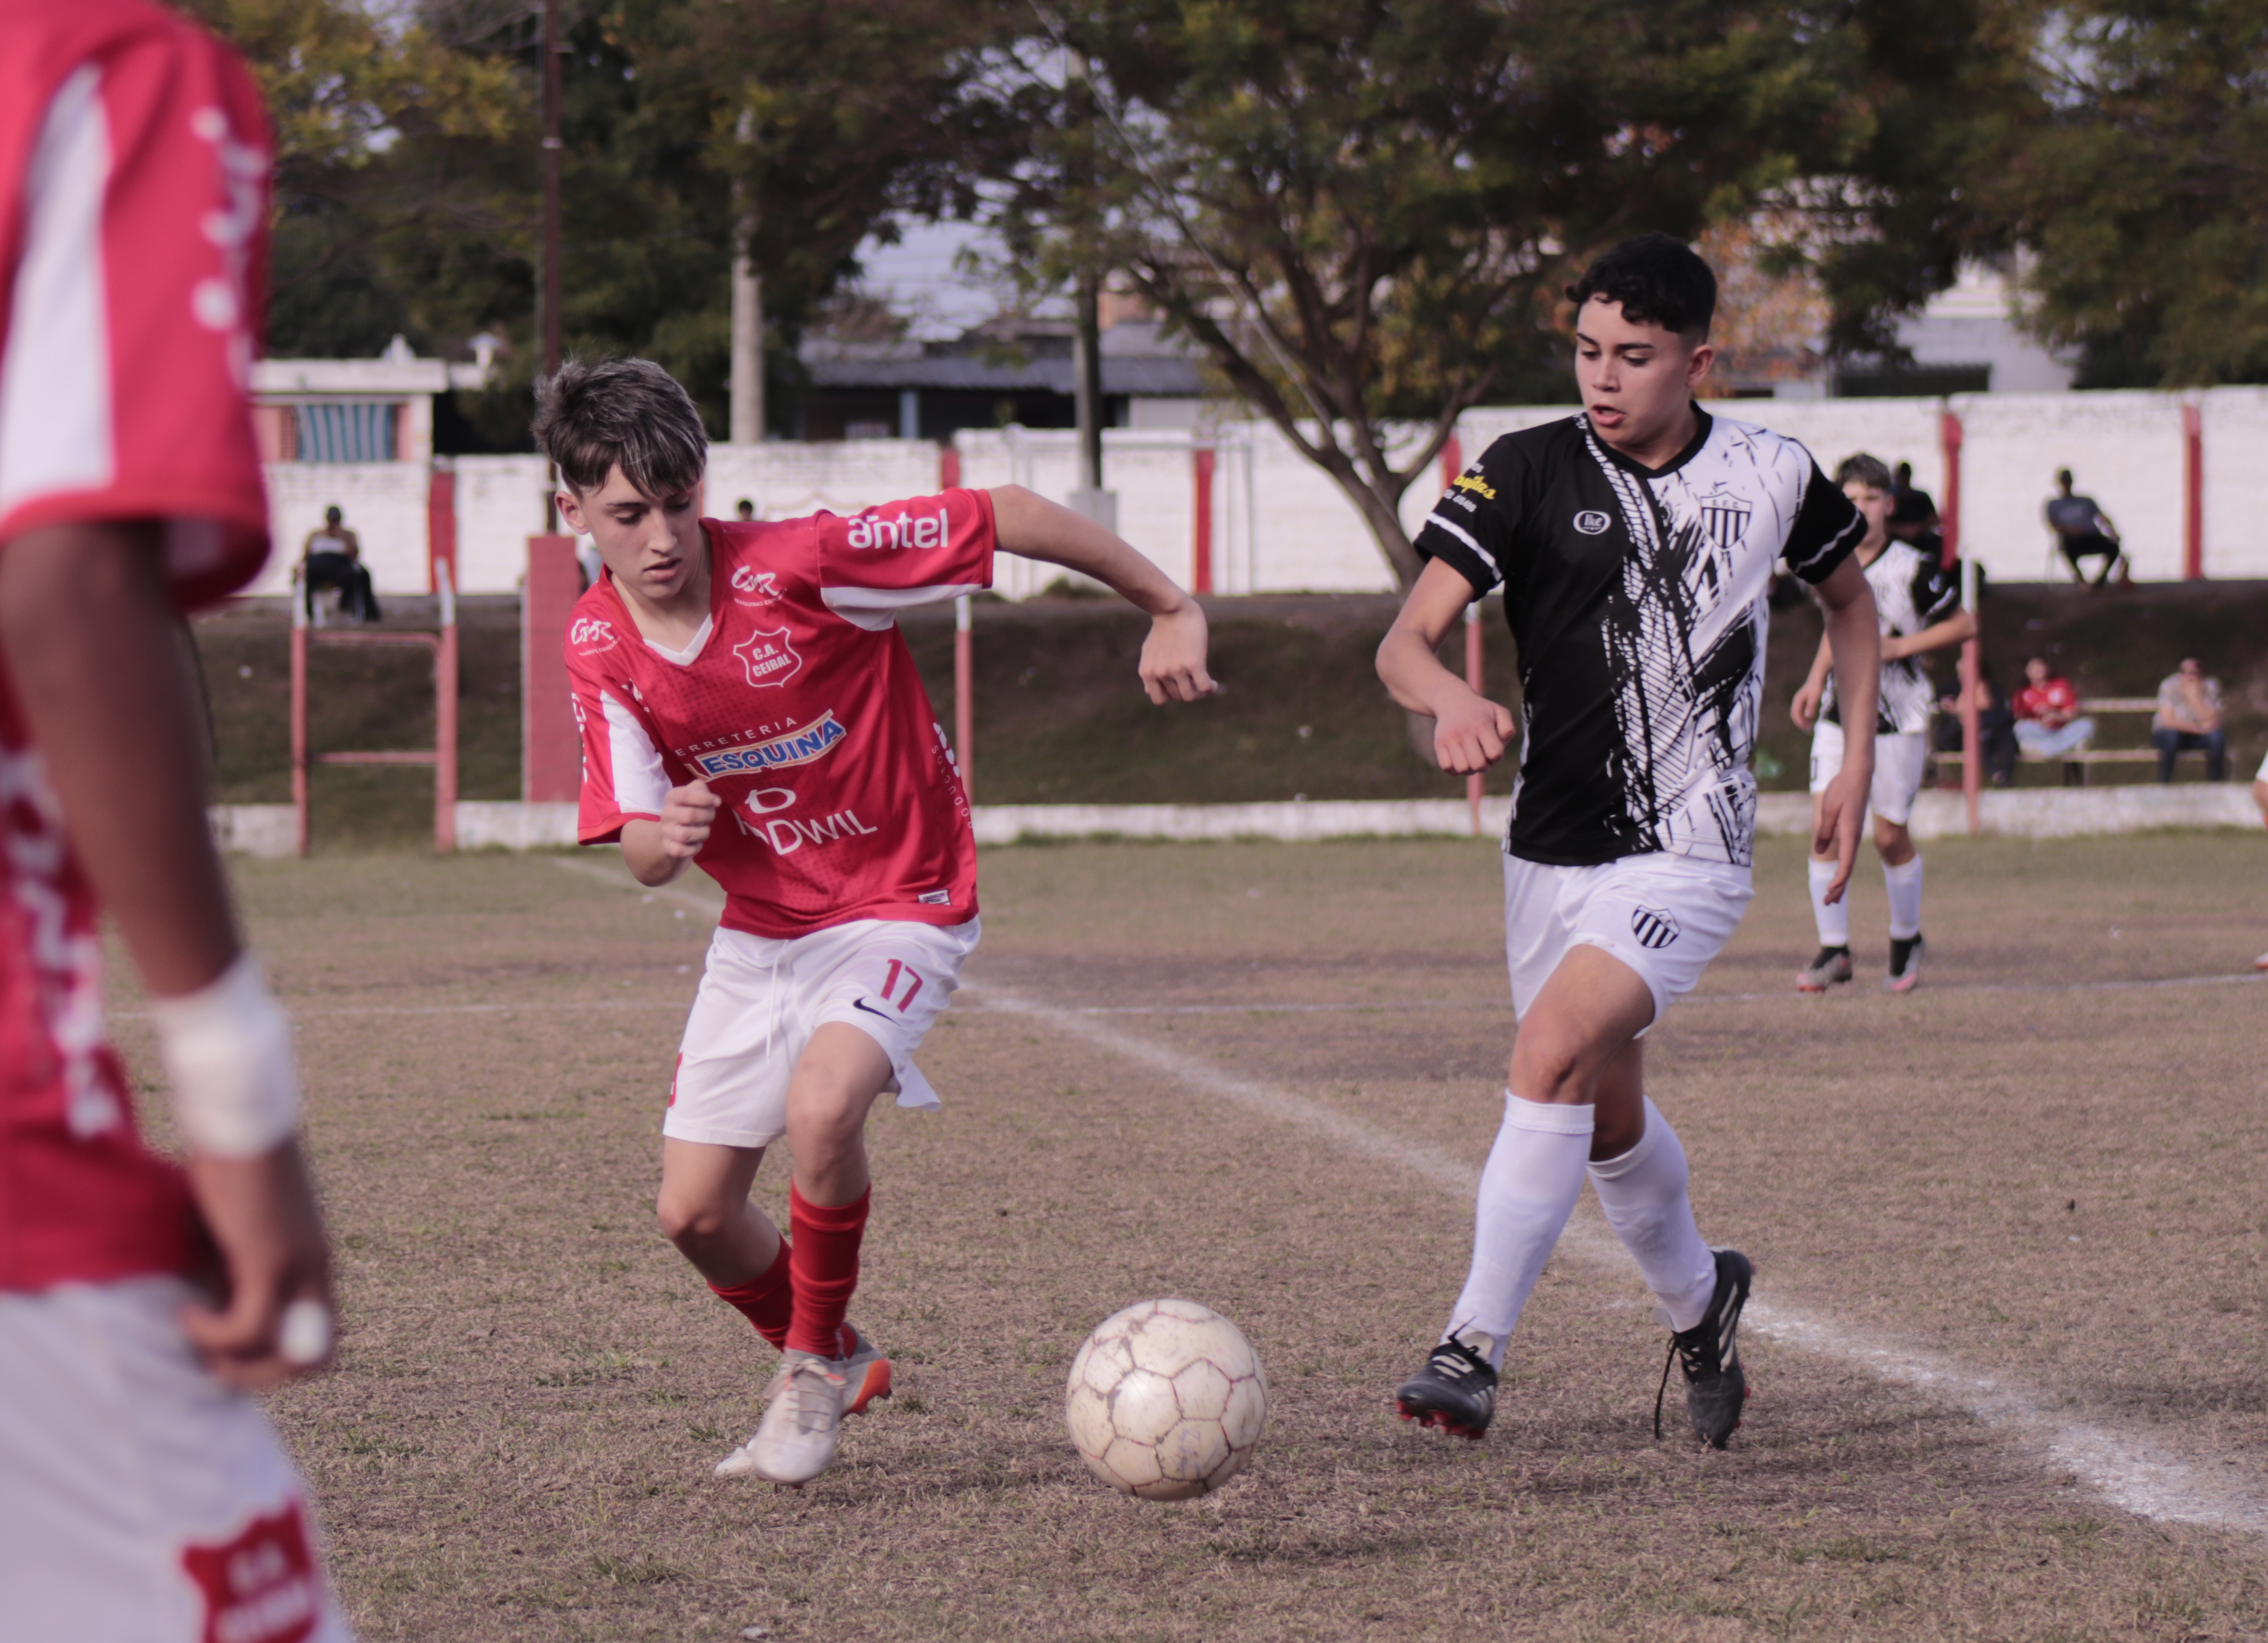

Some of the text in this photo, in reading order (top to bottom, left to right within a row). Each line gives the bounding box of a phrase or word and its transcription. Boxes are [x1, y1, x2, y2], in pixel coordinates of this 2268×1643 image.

[848, 508, 948, 549] antel
[752, 644, 779, 660] C.A.
[752, 653, 792, 677] CEIBAL
[675, 717, 797, 756] ERRETERIA
[700, 719, 844, 774] ESQUINA
[880, 959, 923, 1014] 17
